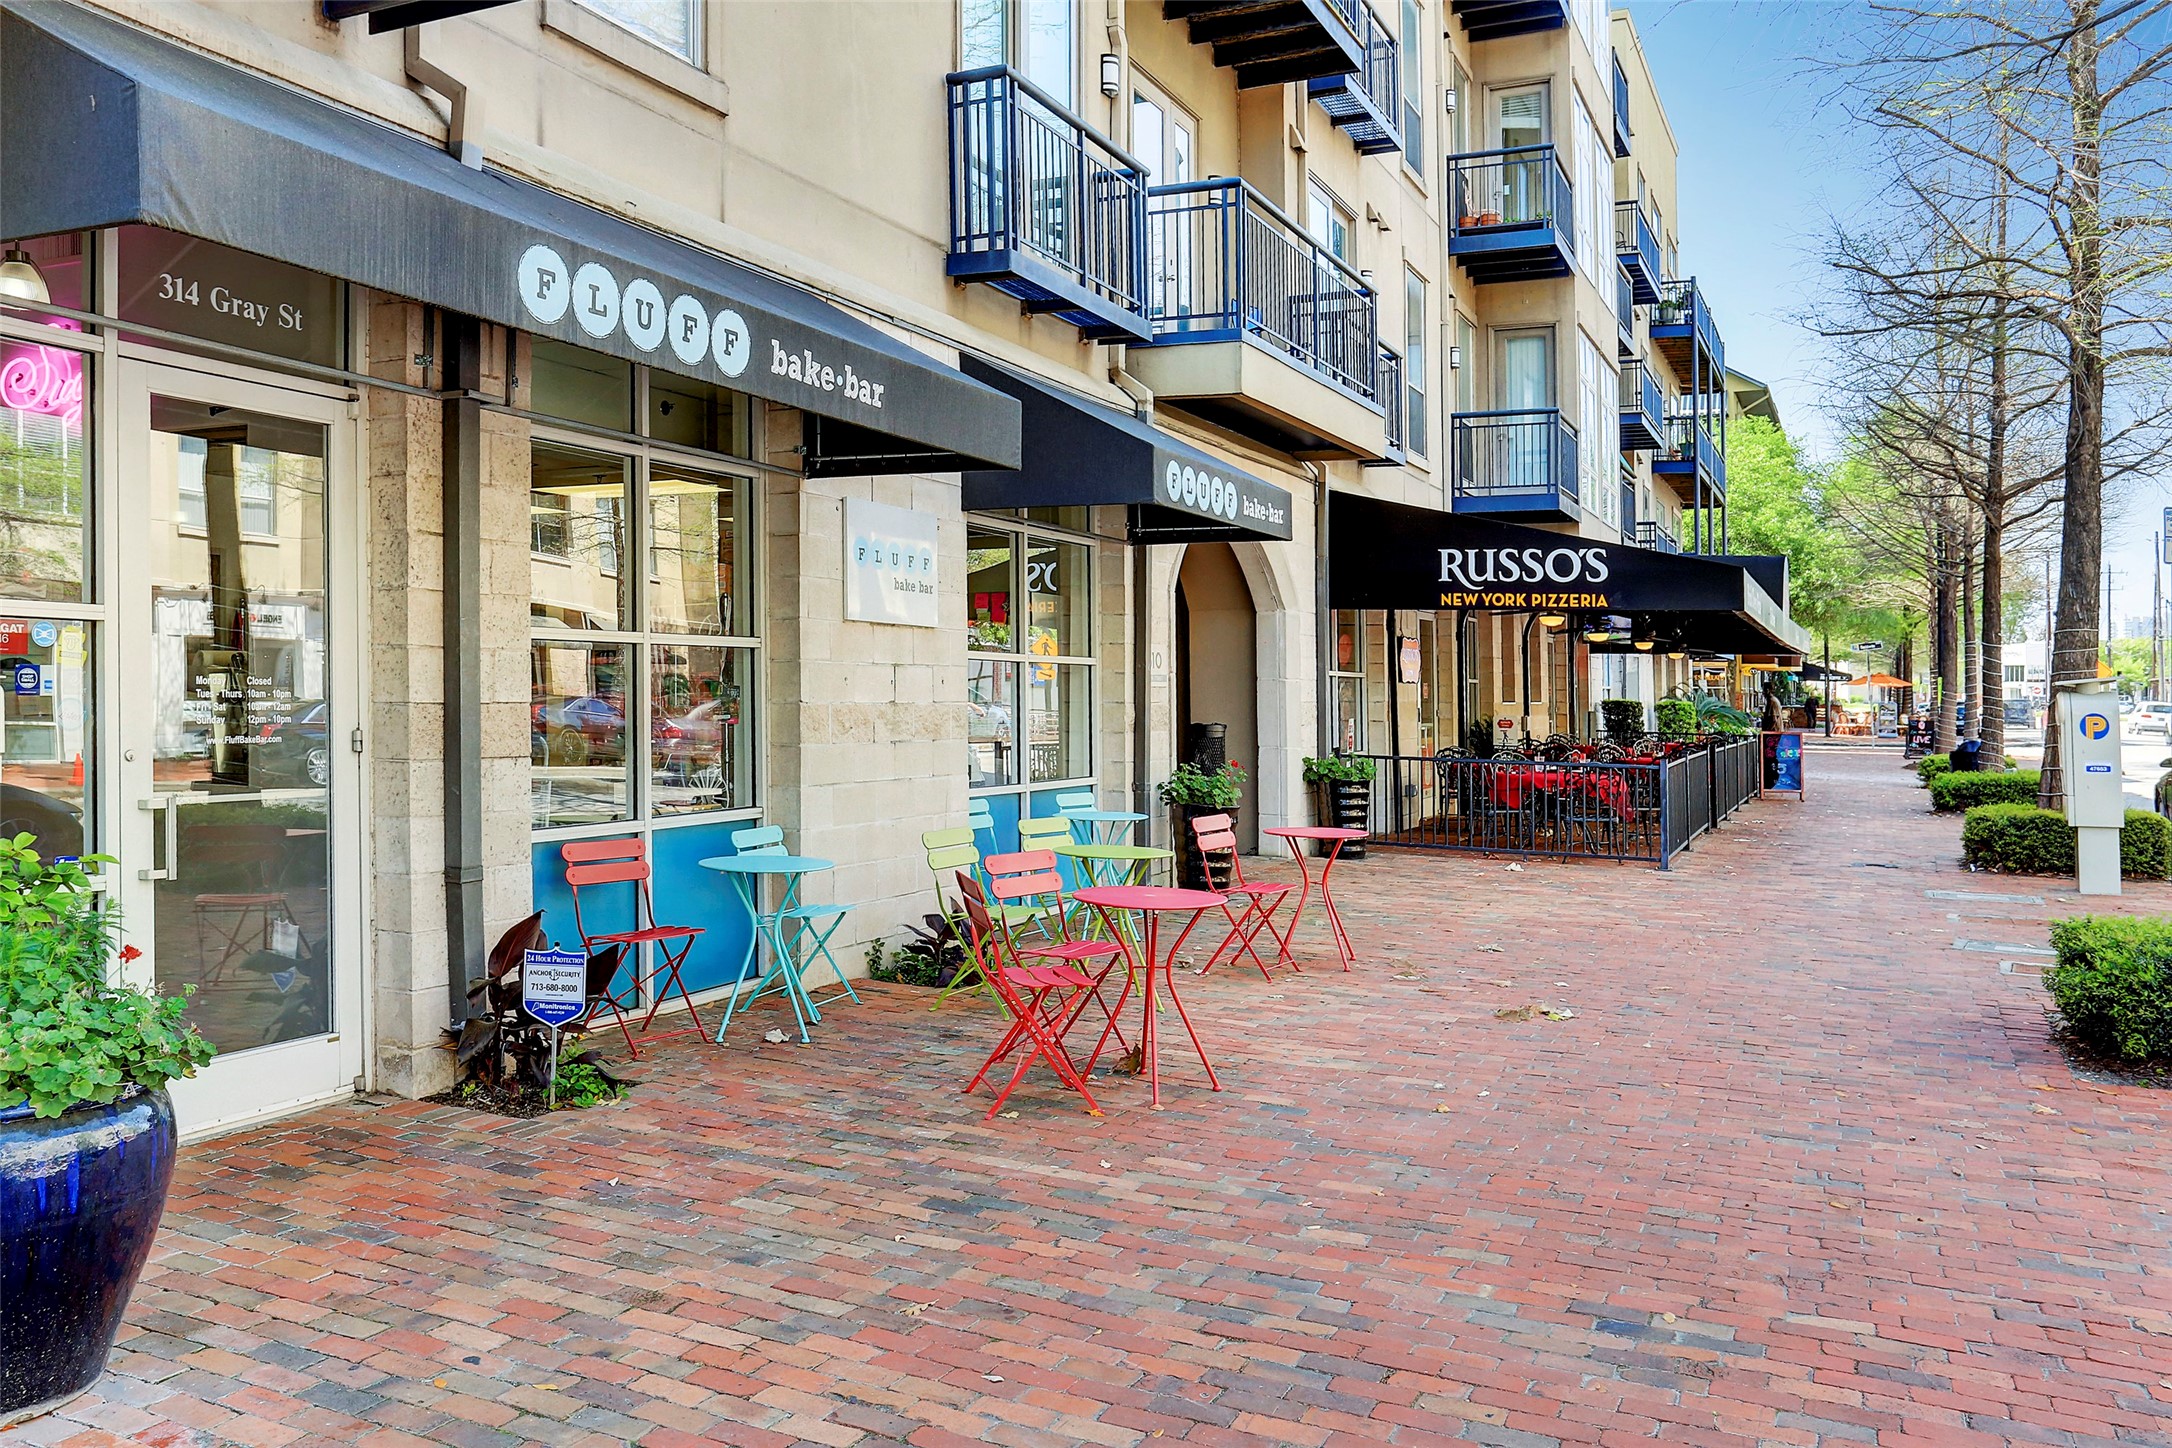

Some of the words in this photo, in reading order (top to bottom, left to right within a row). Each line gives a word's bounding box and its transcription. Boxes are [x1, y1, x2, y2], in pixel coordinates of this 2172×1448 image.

[158, 273, 200, 306] 314
[210, 286, 270, 327] Gray
[278, 303, 303, 331] St
[535, 265, 741, 358] FLUFF
[1170, 471, 1235, 509] FLUFF
[857, 545, 931, 572] FLUFF
[1437, 548, 1609, 591] RUSSO'S
[893, 577, 916, 593] bake
[918, 580, 934, 595] bar
[1440, 593, 1479, 607] NEW
[1481, 593, 1527, 607] YORK
[1531, 593, 1608, 608] PIZZERIA
[195, 675, 227, 686] Monday
[246, 676, 272, 685] Closed
[195, 689, 215, 698] Tues
[220, 689, 243, 698] Thurs
[247, 689, 266, 698] 10am
[272, 689, 291, 699] 10pm
[196, 702, 207, 711] Fri
[213, 702, 227, 711] Sat
[247, 702, 267, 711] 10am
[272, 702, 291, 711] 12am
[195, 715, 226, 726] Sunday
[247, 715, 267, 726] 12pm
[272, 715, 292, 725] 10pm
[527, 954, 535, 962] 24
[528, 969, 552, 977] ANCHOR
[555, 970, 581, 978] SECURITY
[530, 982, 578, 993] 713-680-8000
[539, 1003, 576, 1011] Monitronics
